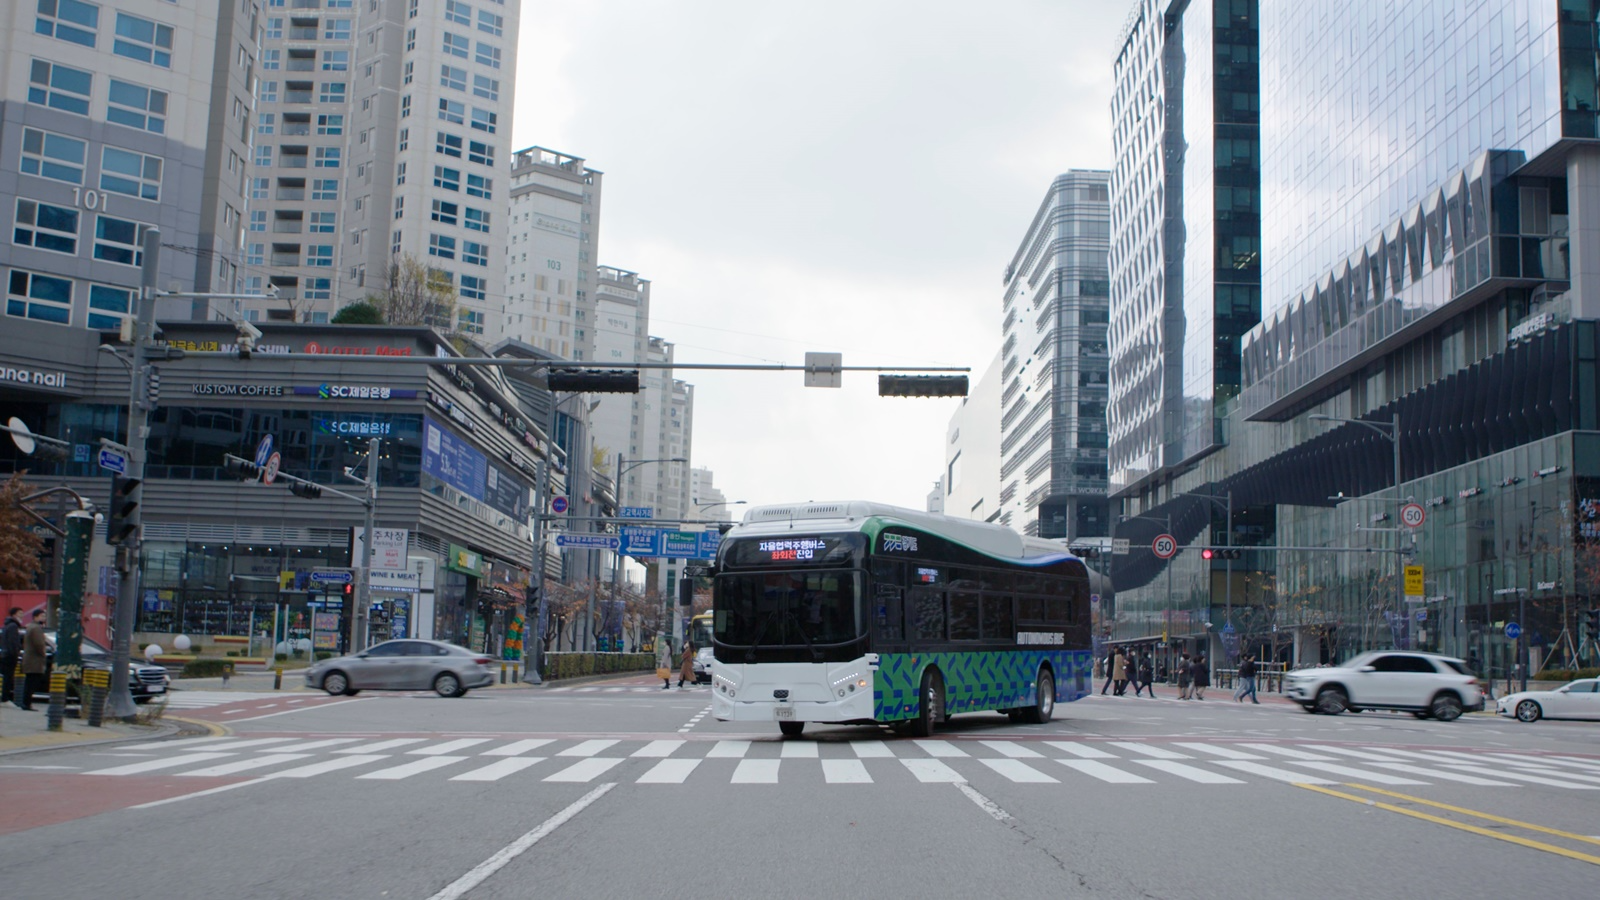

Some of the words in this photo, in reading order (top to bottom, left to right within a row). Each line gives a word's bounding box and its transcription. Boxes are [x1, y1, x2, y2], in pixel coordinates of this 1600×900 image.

[72, 187, 108, 212] 101
[547, 259, 561, 271] 103
[375, 345, 412, 356] Mart
[611, 350, 622, 358] 104
[33, 372, 65, 388] nail
[192, 384, 237, 395] KUSTOM
[239, 385, 282, 396] COFFEE
[331, 386, 391, 399] SC제일은행
[331, 421, 391, 434] SC제일은행
[620, 507, 652, 518] 판교역사거리
[1406, 511, 1421, 521] 50
[373, 530, 405, 542] 주차장
[759, 540, 826, 551] 자율협력주행버스
[1158, 541, 1172, 552] 50
[771, 549, 813, 560] 좌회전진입
